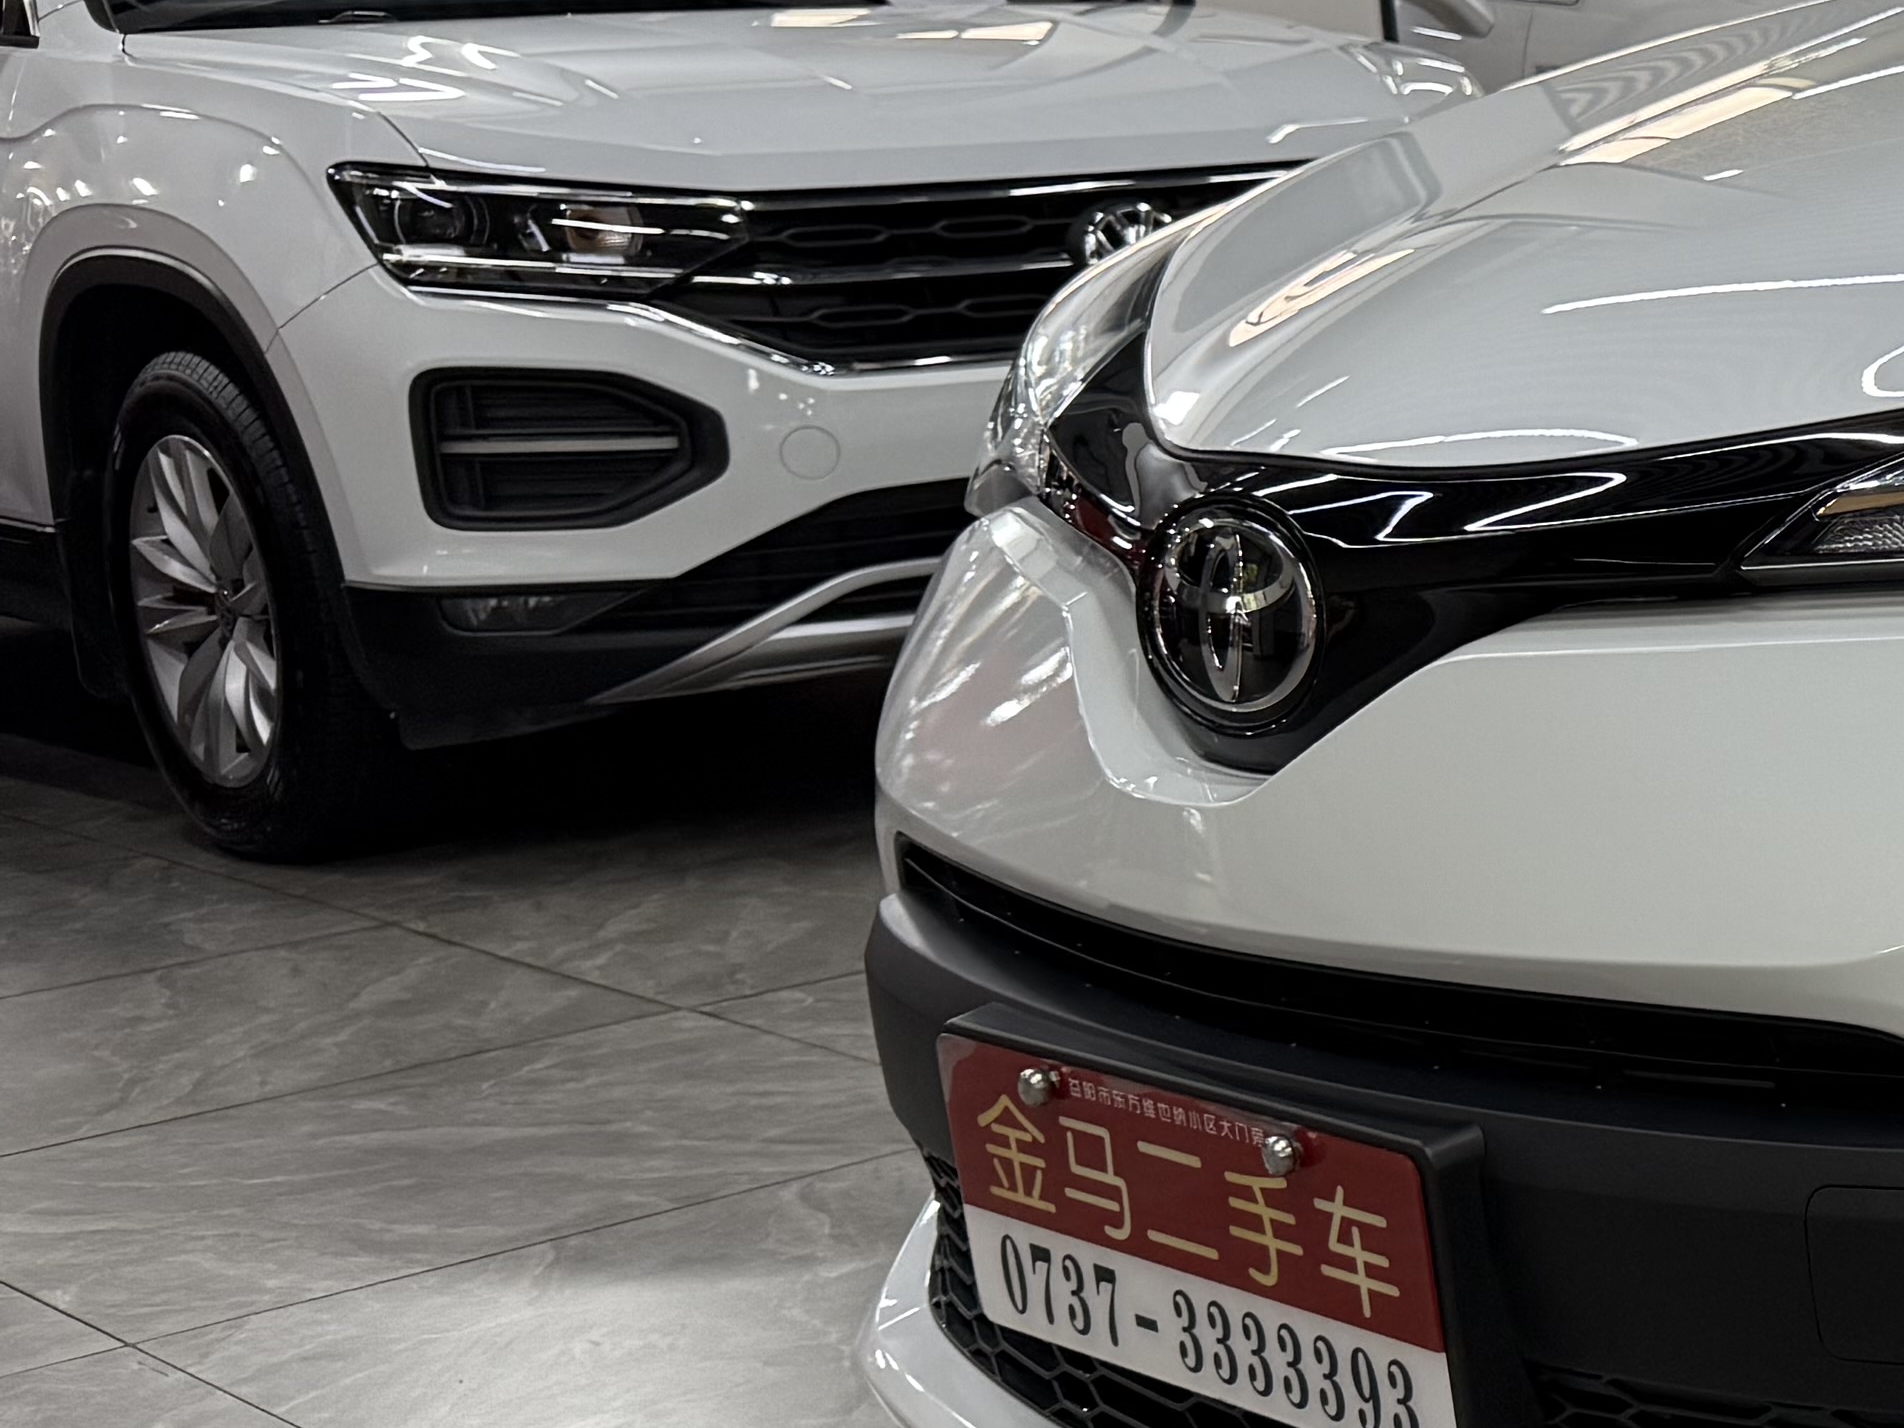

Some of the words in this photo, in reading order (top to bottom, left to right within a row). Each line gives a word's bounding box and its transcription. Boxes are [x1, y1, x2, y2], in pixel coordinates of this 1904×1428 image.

[977, 1094, 1400, 1319] 金马二手车
